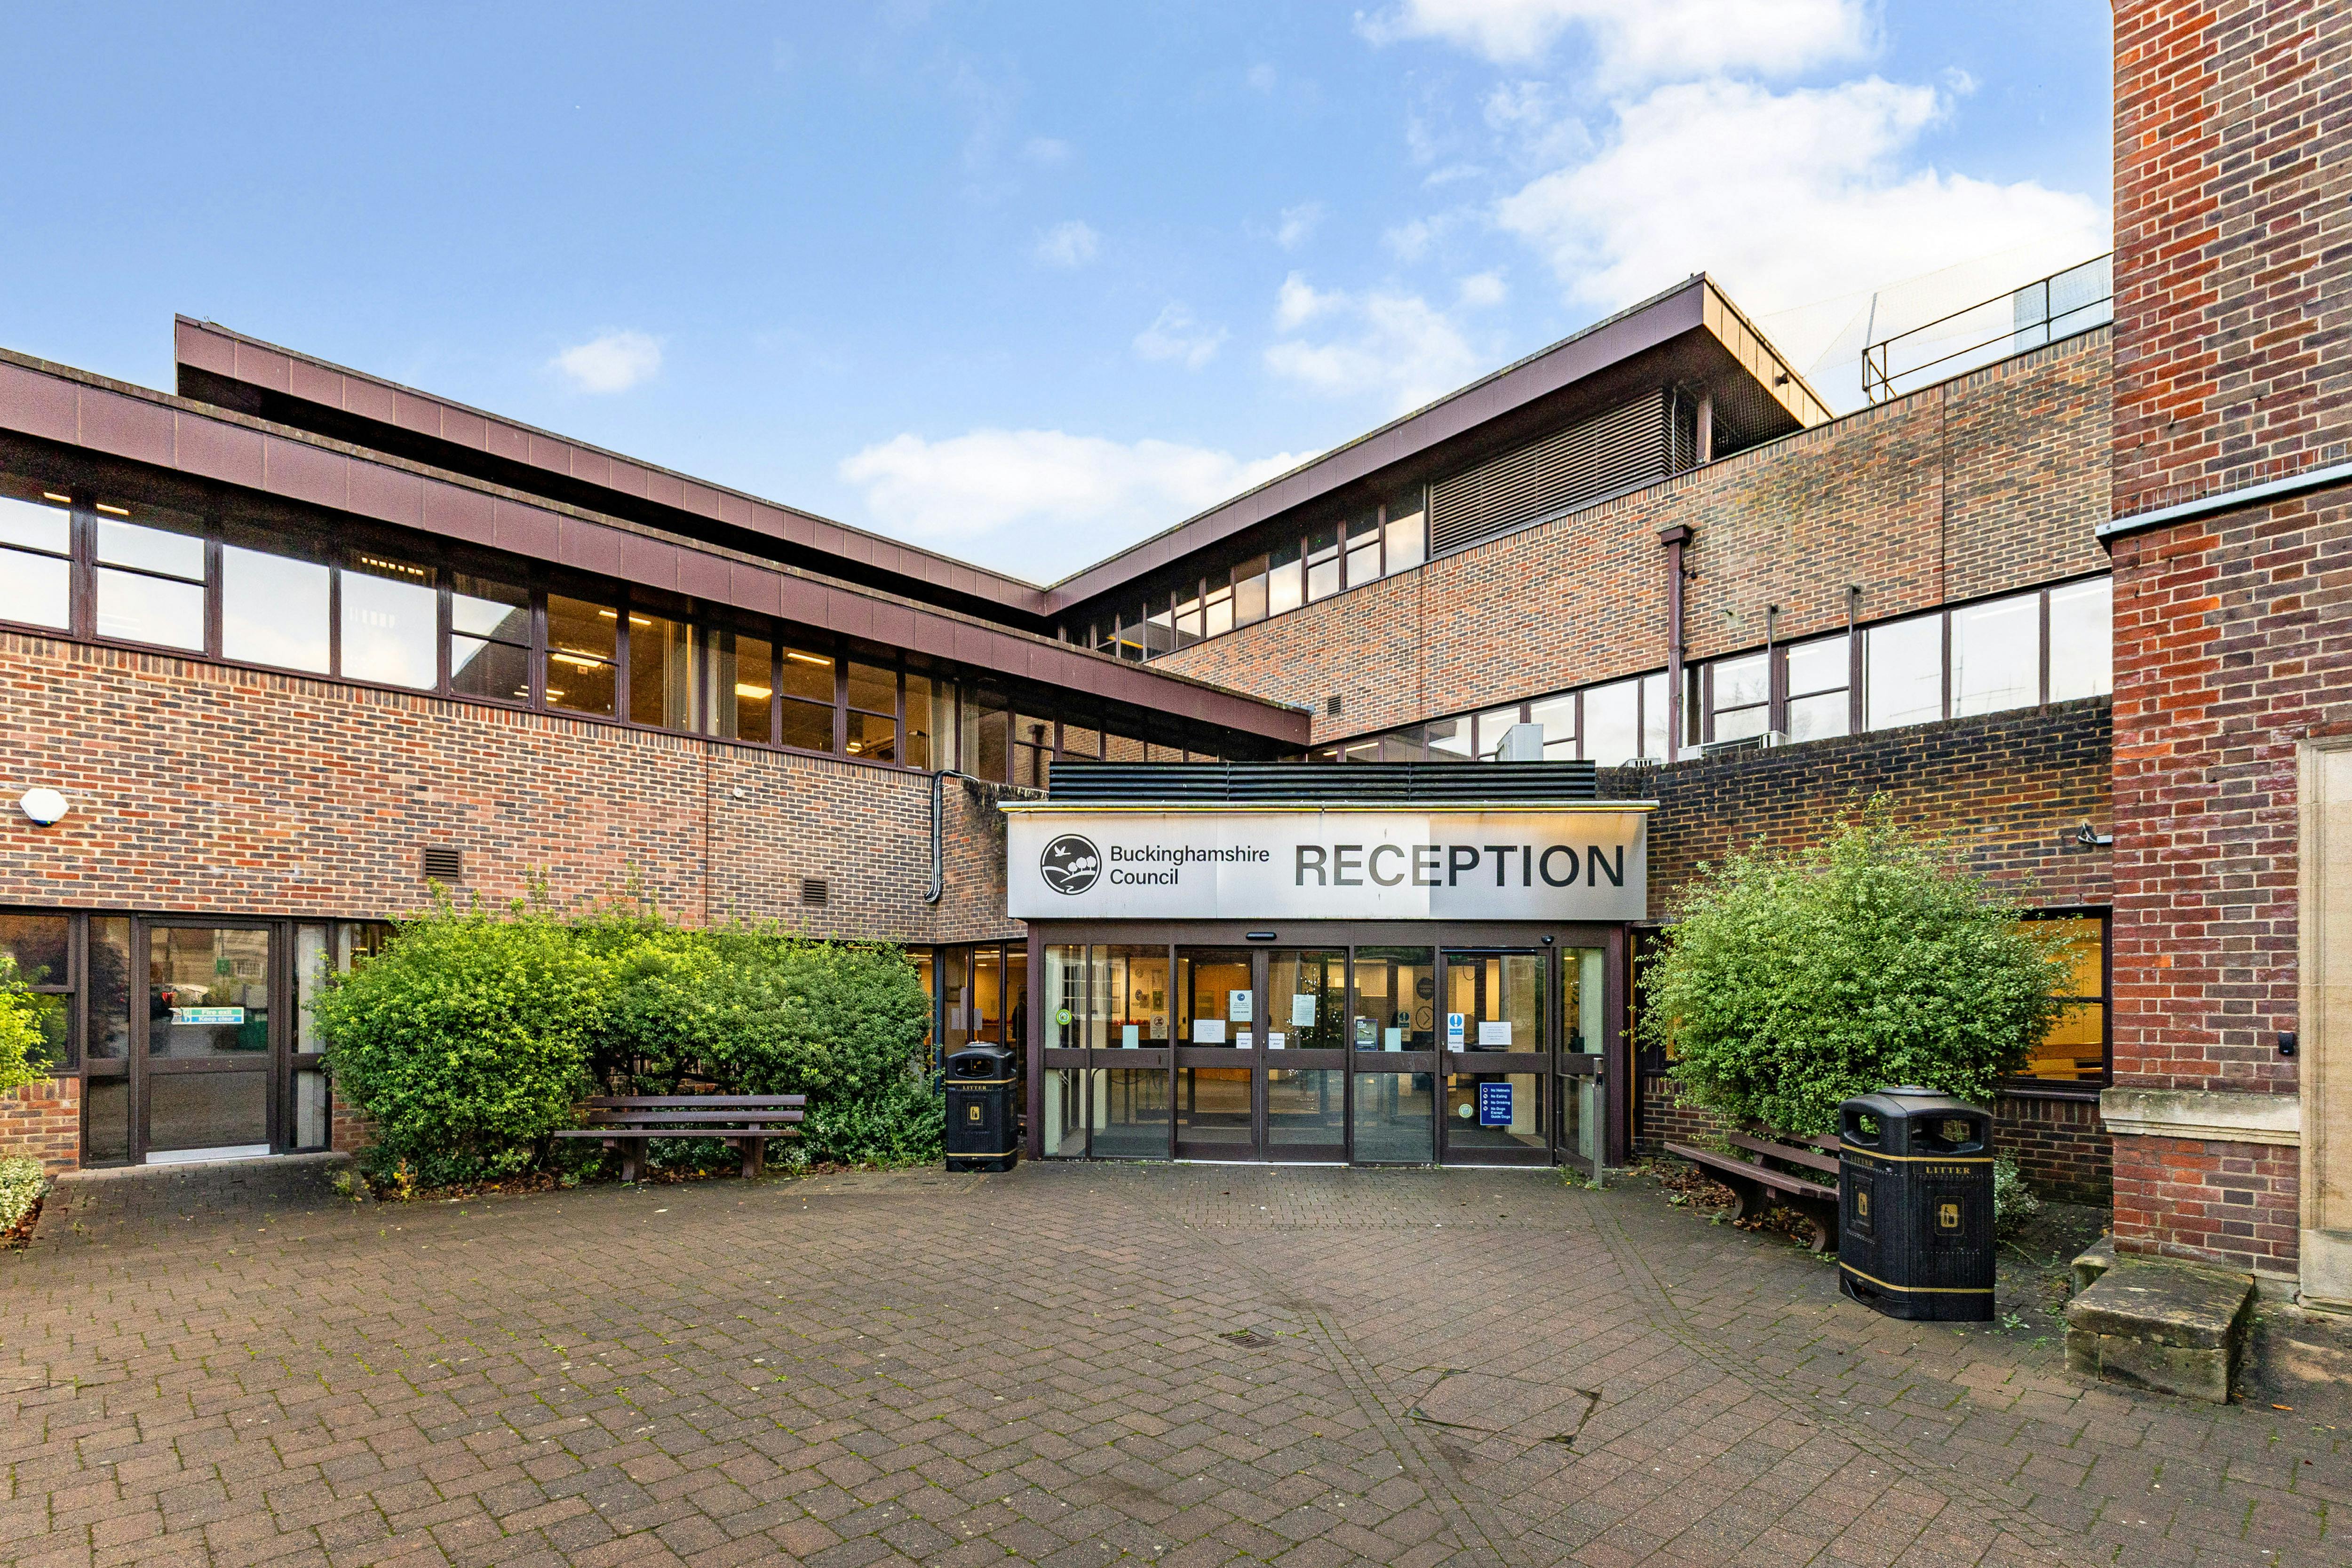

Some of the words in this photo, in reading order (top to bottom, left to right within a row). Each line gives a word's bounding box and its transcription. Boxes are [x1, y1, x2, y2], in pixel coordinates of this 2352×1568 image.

[1111, 845, 1269, 865] Buckinghamshire
[1296, 845, 1623, 887] RECEPTION
[1111, 868, 1177, 884] Council
[1851, 1155, 1874, 1167] LITTER
